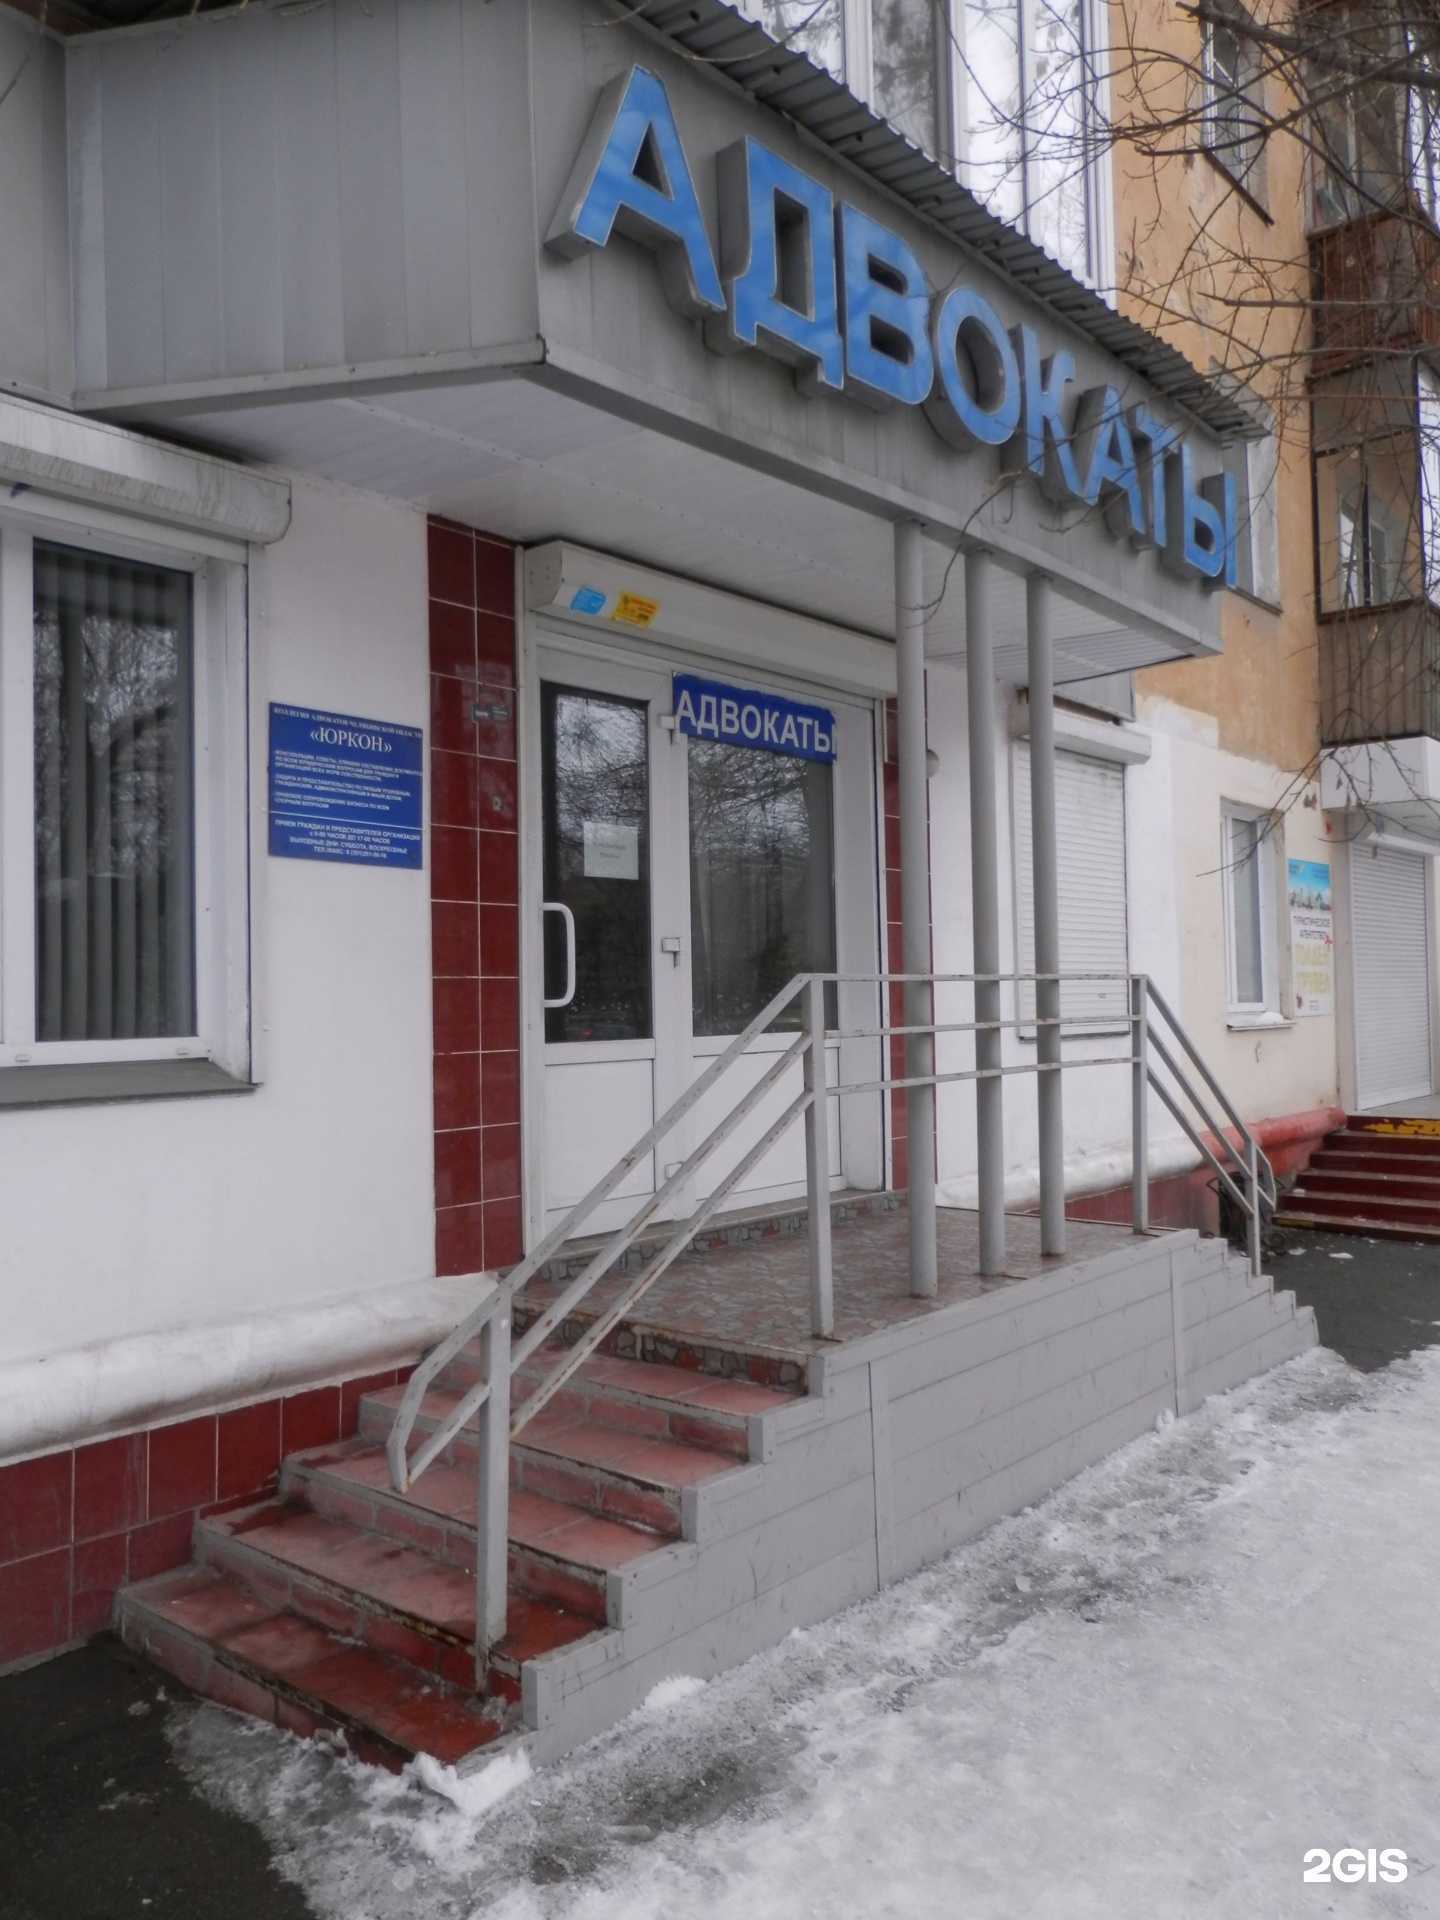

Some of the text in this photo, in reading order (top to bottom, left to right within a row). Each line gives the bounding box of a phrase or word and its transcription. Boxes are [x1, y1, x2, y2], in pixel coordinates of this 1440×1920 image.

[572, 64, 1238, 588] АДВОКАТЫ
[310, 727, 392, 753] «ЮРКОН»
[676, 689, 837, 753] АДВОКАТЫ
